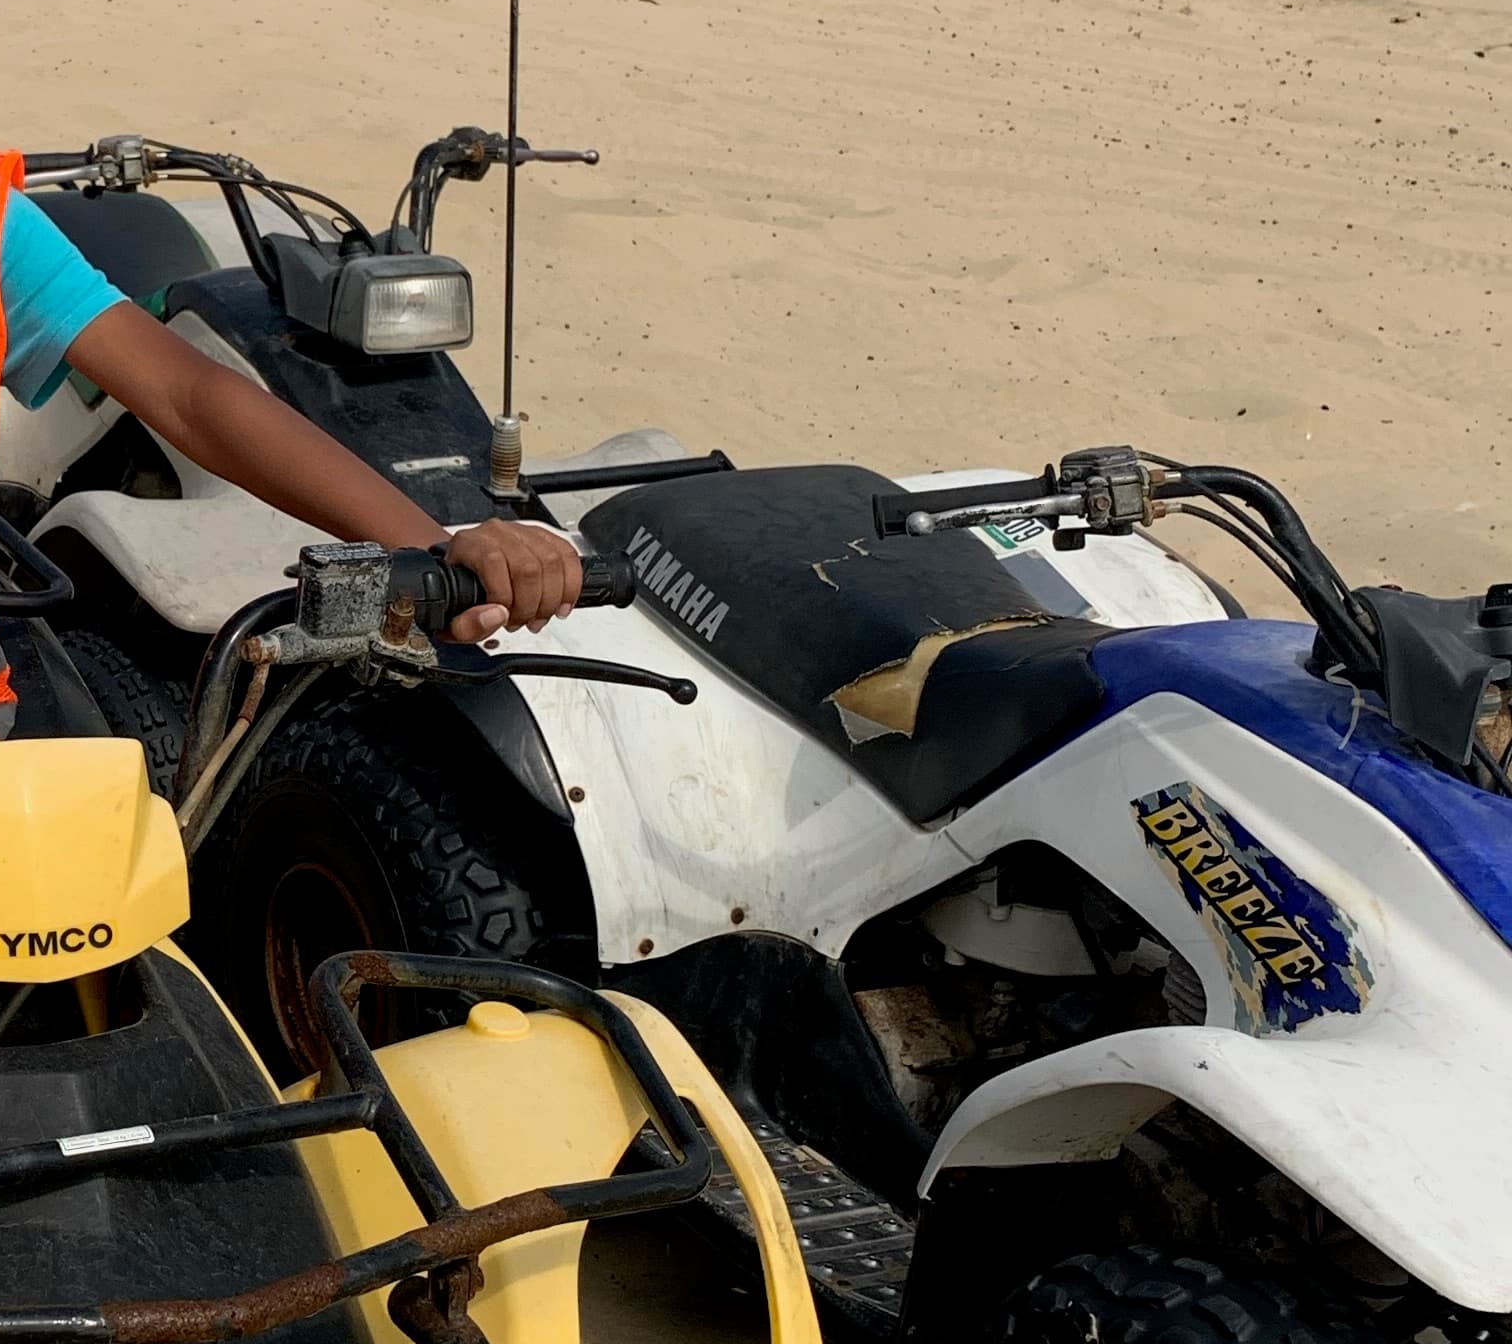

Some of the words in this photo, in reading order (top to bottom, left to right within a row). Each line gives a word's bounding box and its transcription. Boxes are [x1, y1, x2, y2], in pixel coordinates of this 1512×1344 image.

[625, 525, 730, 643] YAMAHA
[997, 517, 1045, 543] 09
[1138, 797, 1326, 985] BREEZE
